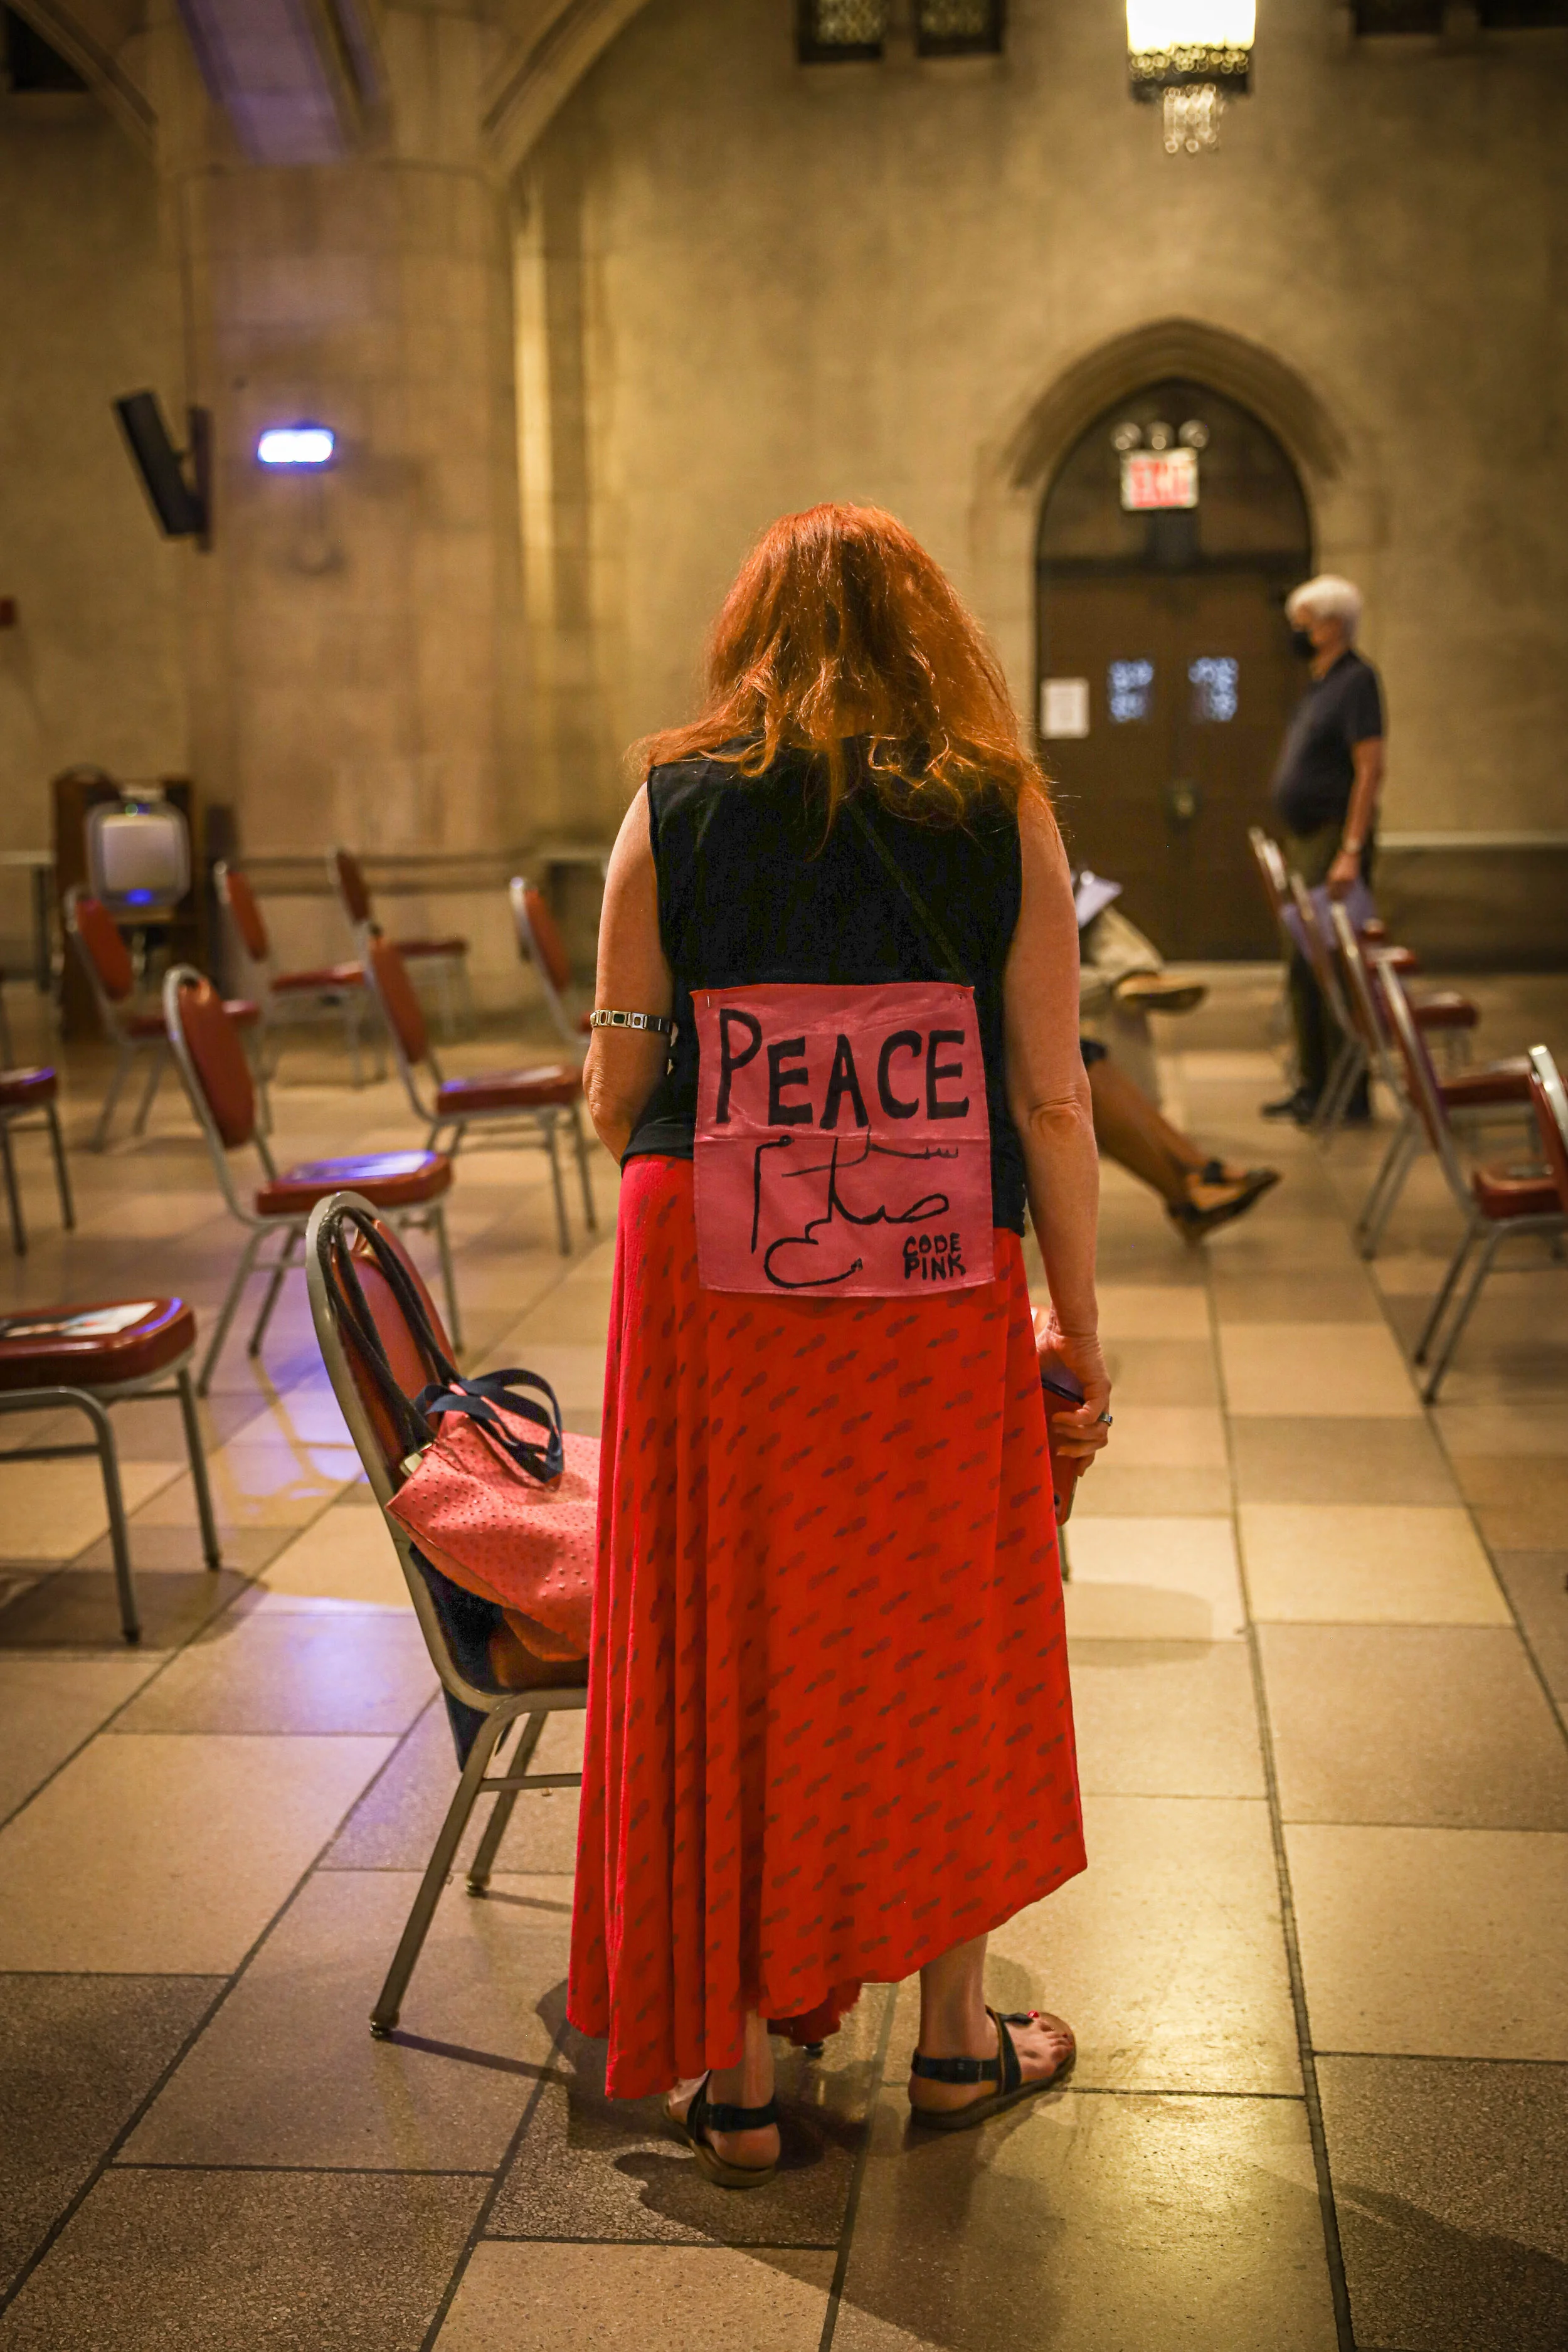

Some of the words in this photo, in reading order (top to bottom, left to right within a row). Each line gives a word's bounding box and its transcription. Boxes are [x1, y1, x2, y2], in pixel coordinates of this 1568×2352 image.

[716, 1009, 970, 1130] PEACE
[903, 1232, 961, 1256] CODE
[904, 1254, 966, 1281] PINK
